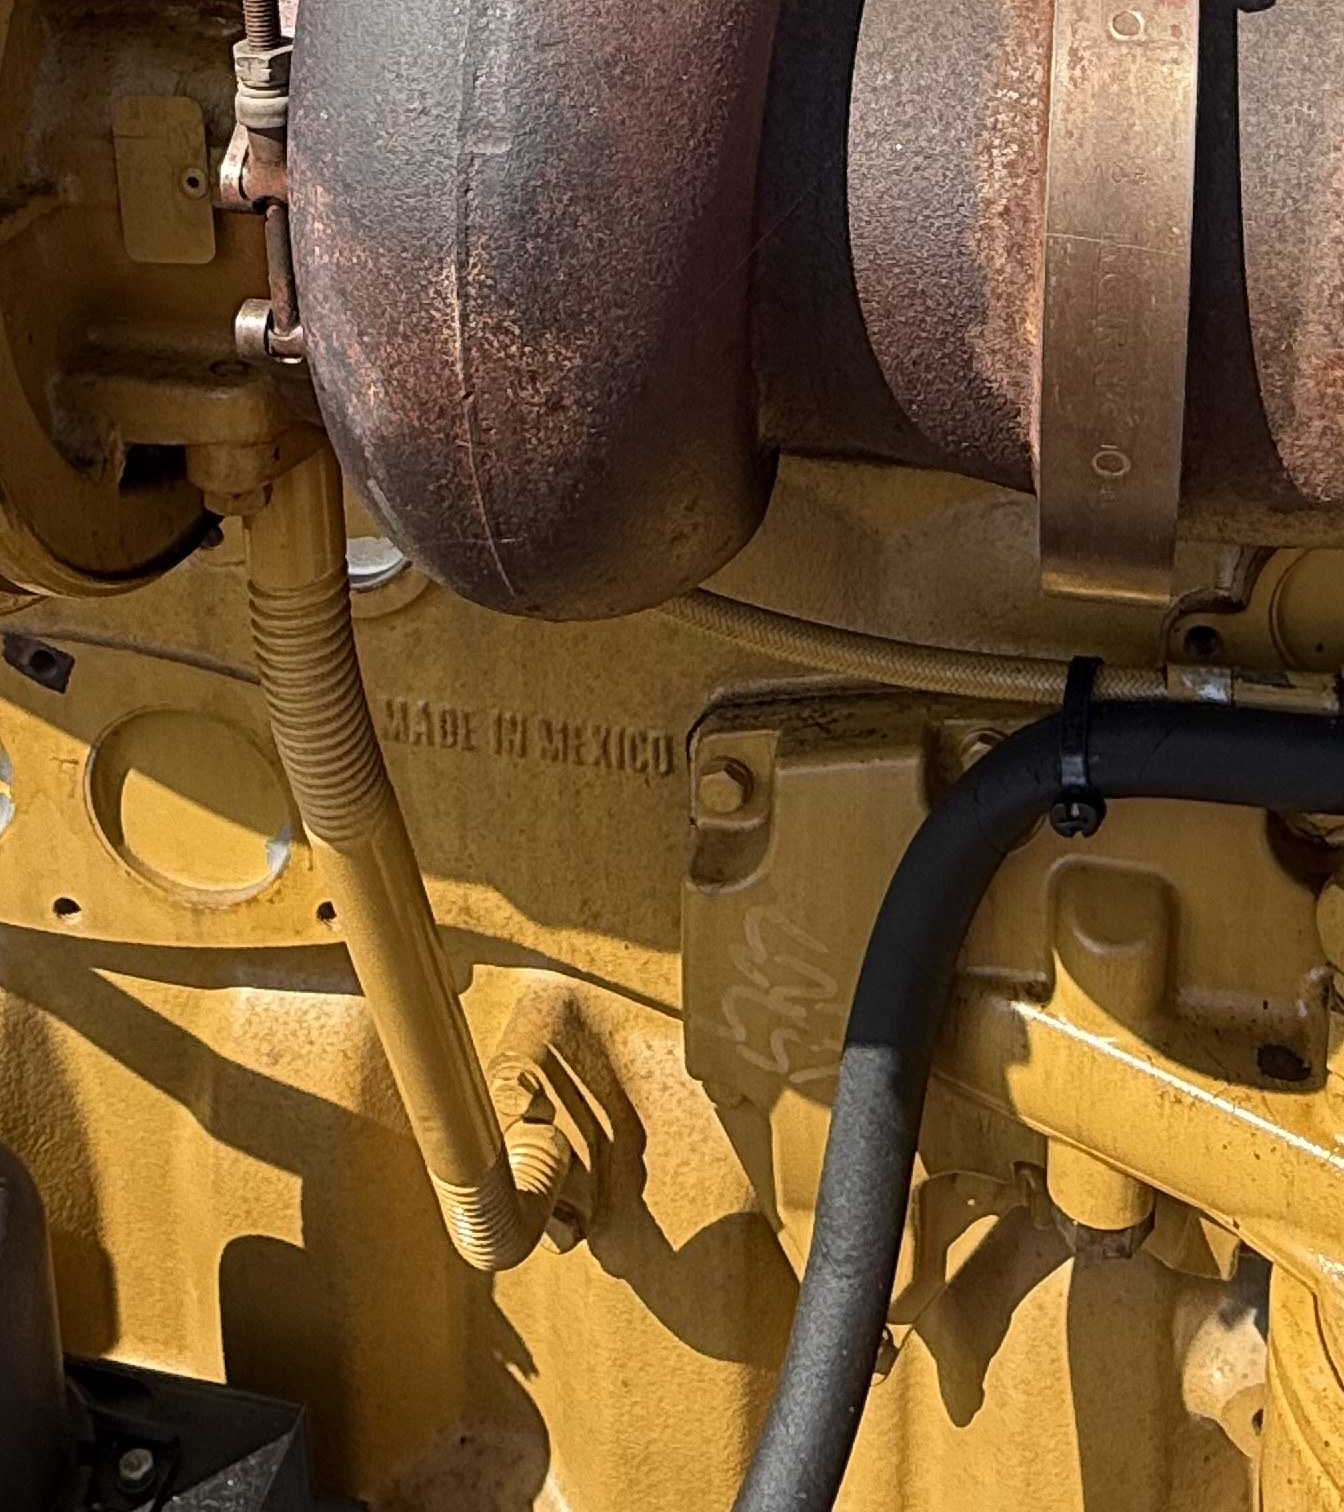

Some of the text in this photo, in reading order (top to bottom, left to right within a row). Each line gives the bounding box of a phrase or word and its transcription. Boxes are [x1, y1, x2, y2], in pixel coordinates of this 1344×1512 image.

[378, 695, 675, 777] MADE IN MEXICO
